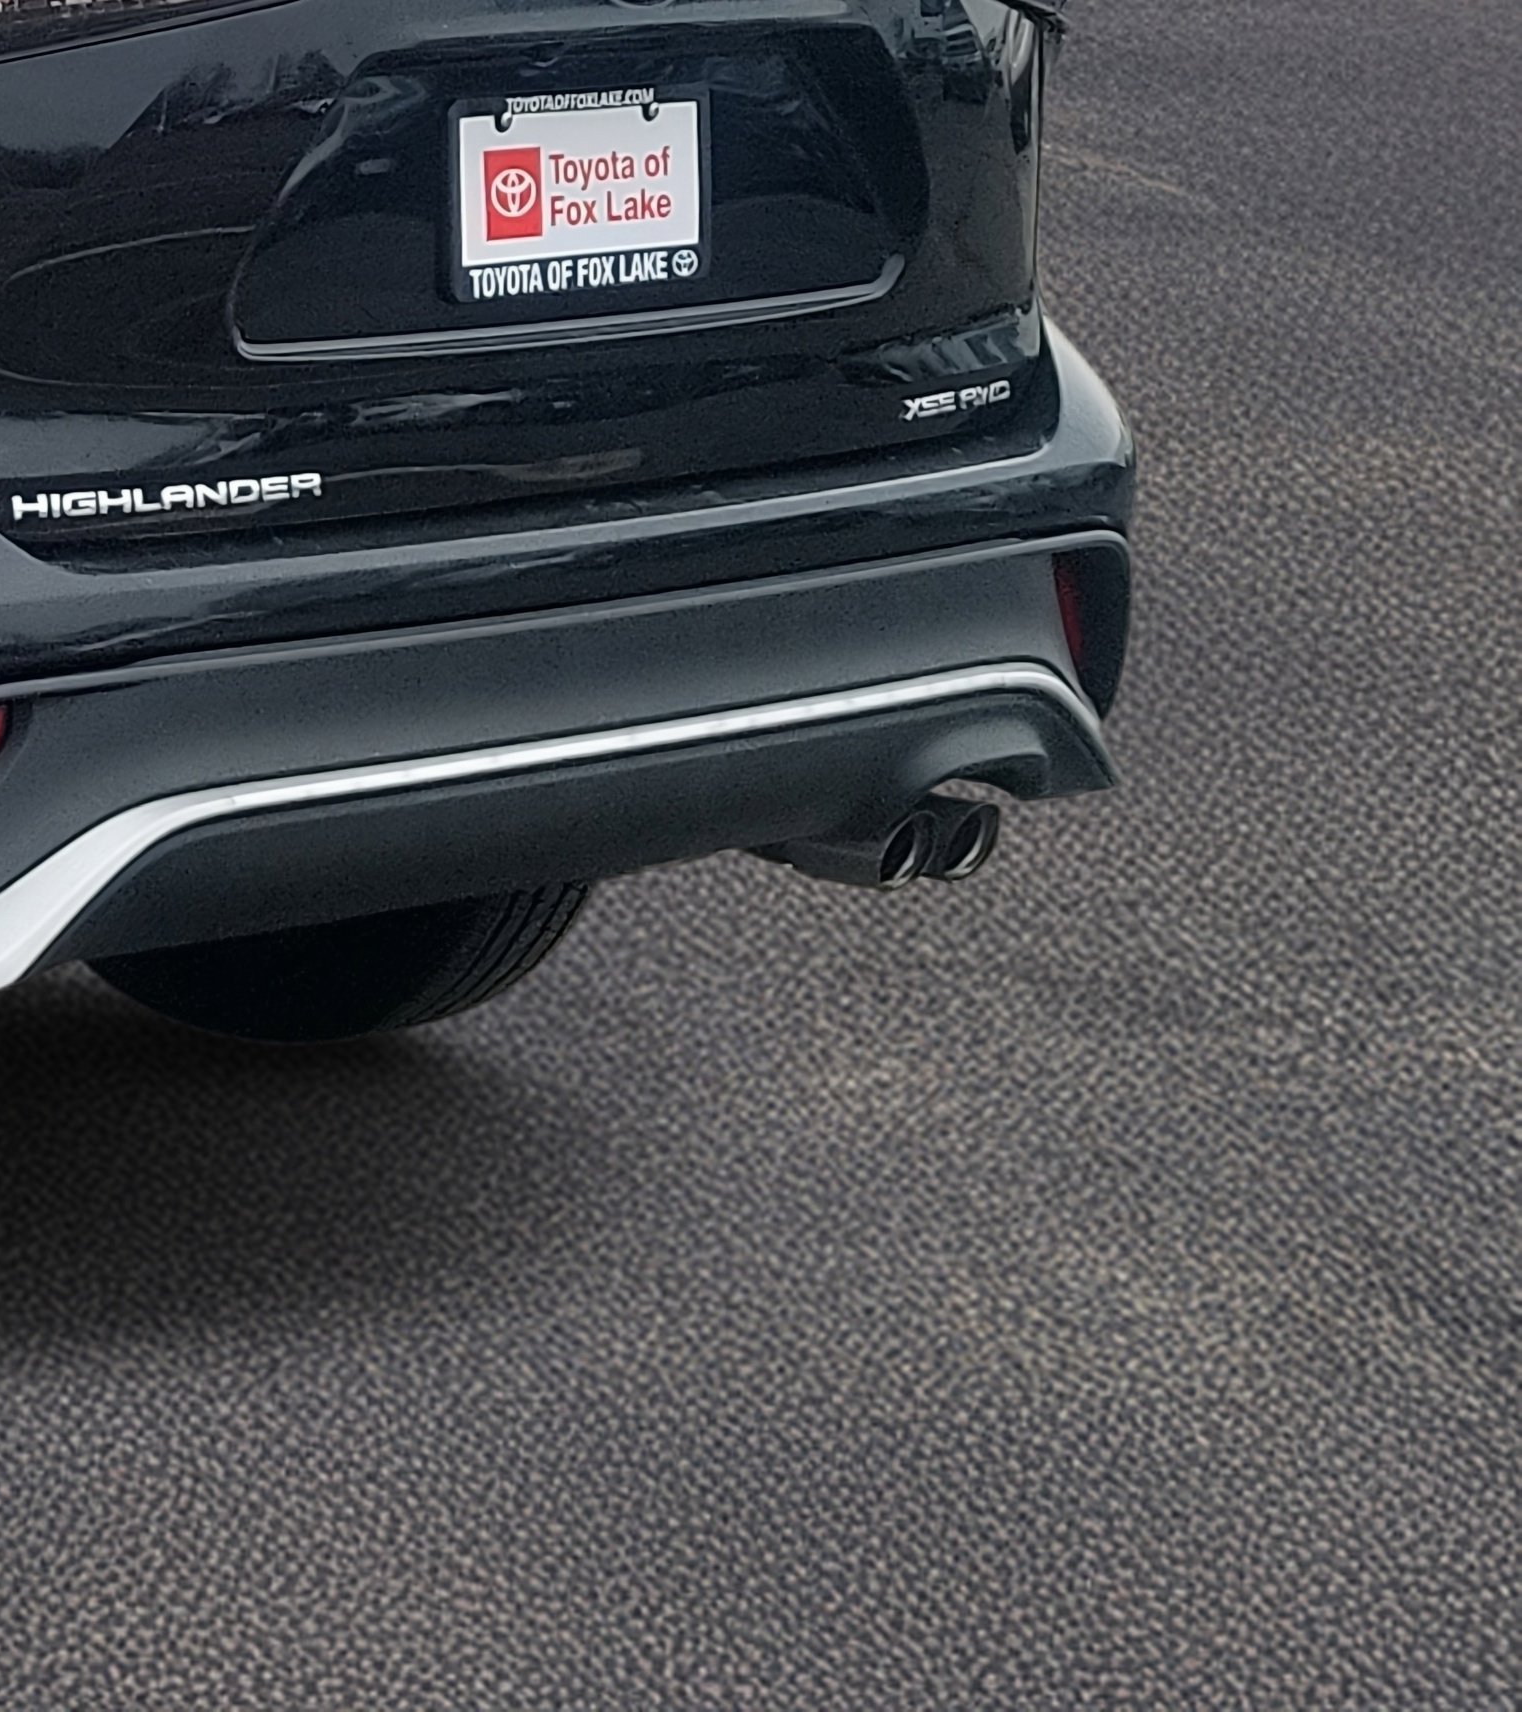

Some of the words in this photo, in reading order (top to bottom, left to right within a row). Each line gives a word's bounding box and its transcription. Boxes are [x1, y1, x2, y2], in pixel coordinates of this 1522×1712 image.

[548, 151, 635, 191] Toyota
[644, 145, 671, 177] of
[550, 194, 598, 227] Fox
[606, 188, 672, 222] Lake
[469, 262, 544, 300] TOYOTA
[547, 258, 573, 291] OF
[577, 255, 615, 288] FOX
[619, 250, 668, 283] LAKE
[899, 391, 956, 421] XSE
[11, 473, 322, 520] HIGHLANDER
